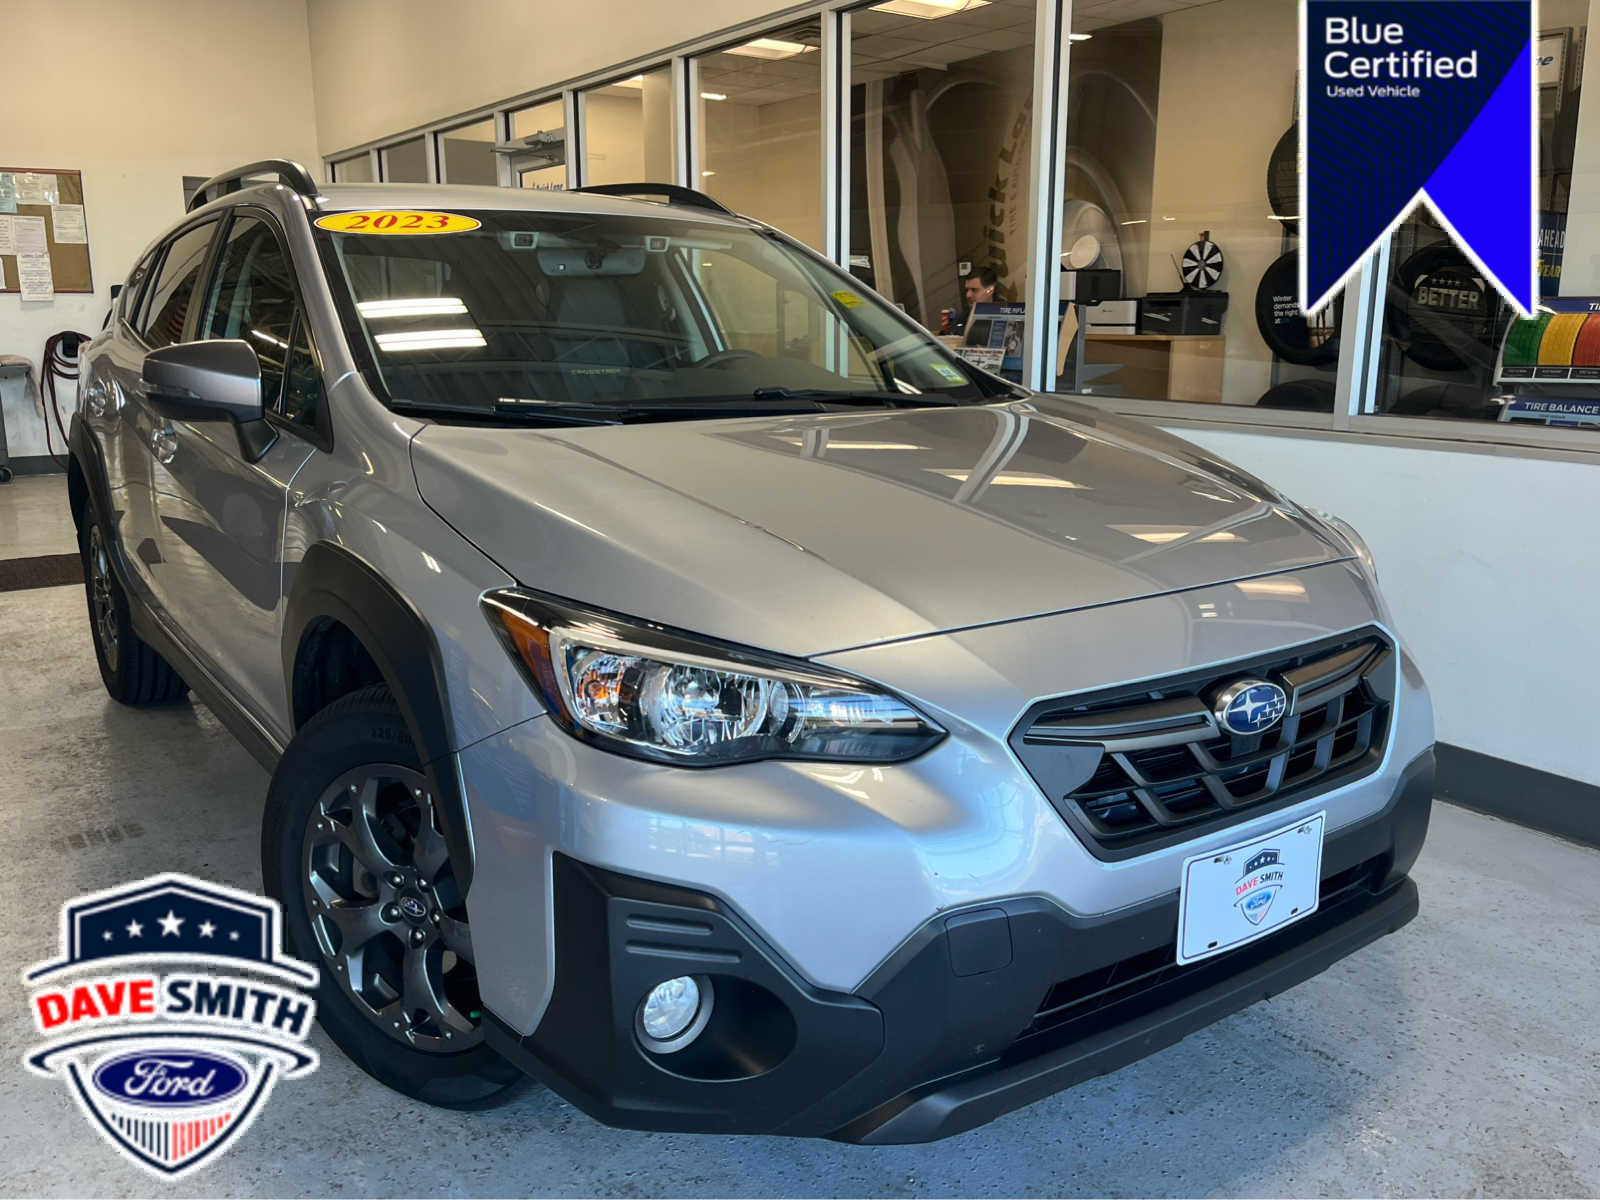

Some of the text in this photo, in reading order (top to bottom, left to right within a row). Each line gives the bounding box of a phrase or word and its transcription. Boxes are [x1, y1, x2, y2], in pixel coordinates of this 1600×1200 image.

[345, 214, 449, 230] 2023
[1417, 287, 1480, 310] BETTER
[1525, 402, 1599, 414] TIRE BALANCE
[1236, 871, 1284, 897] DAVE SMITH
